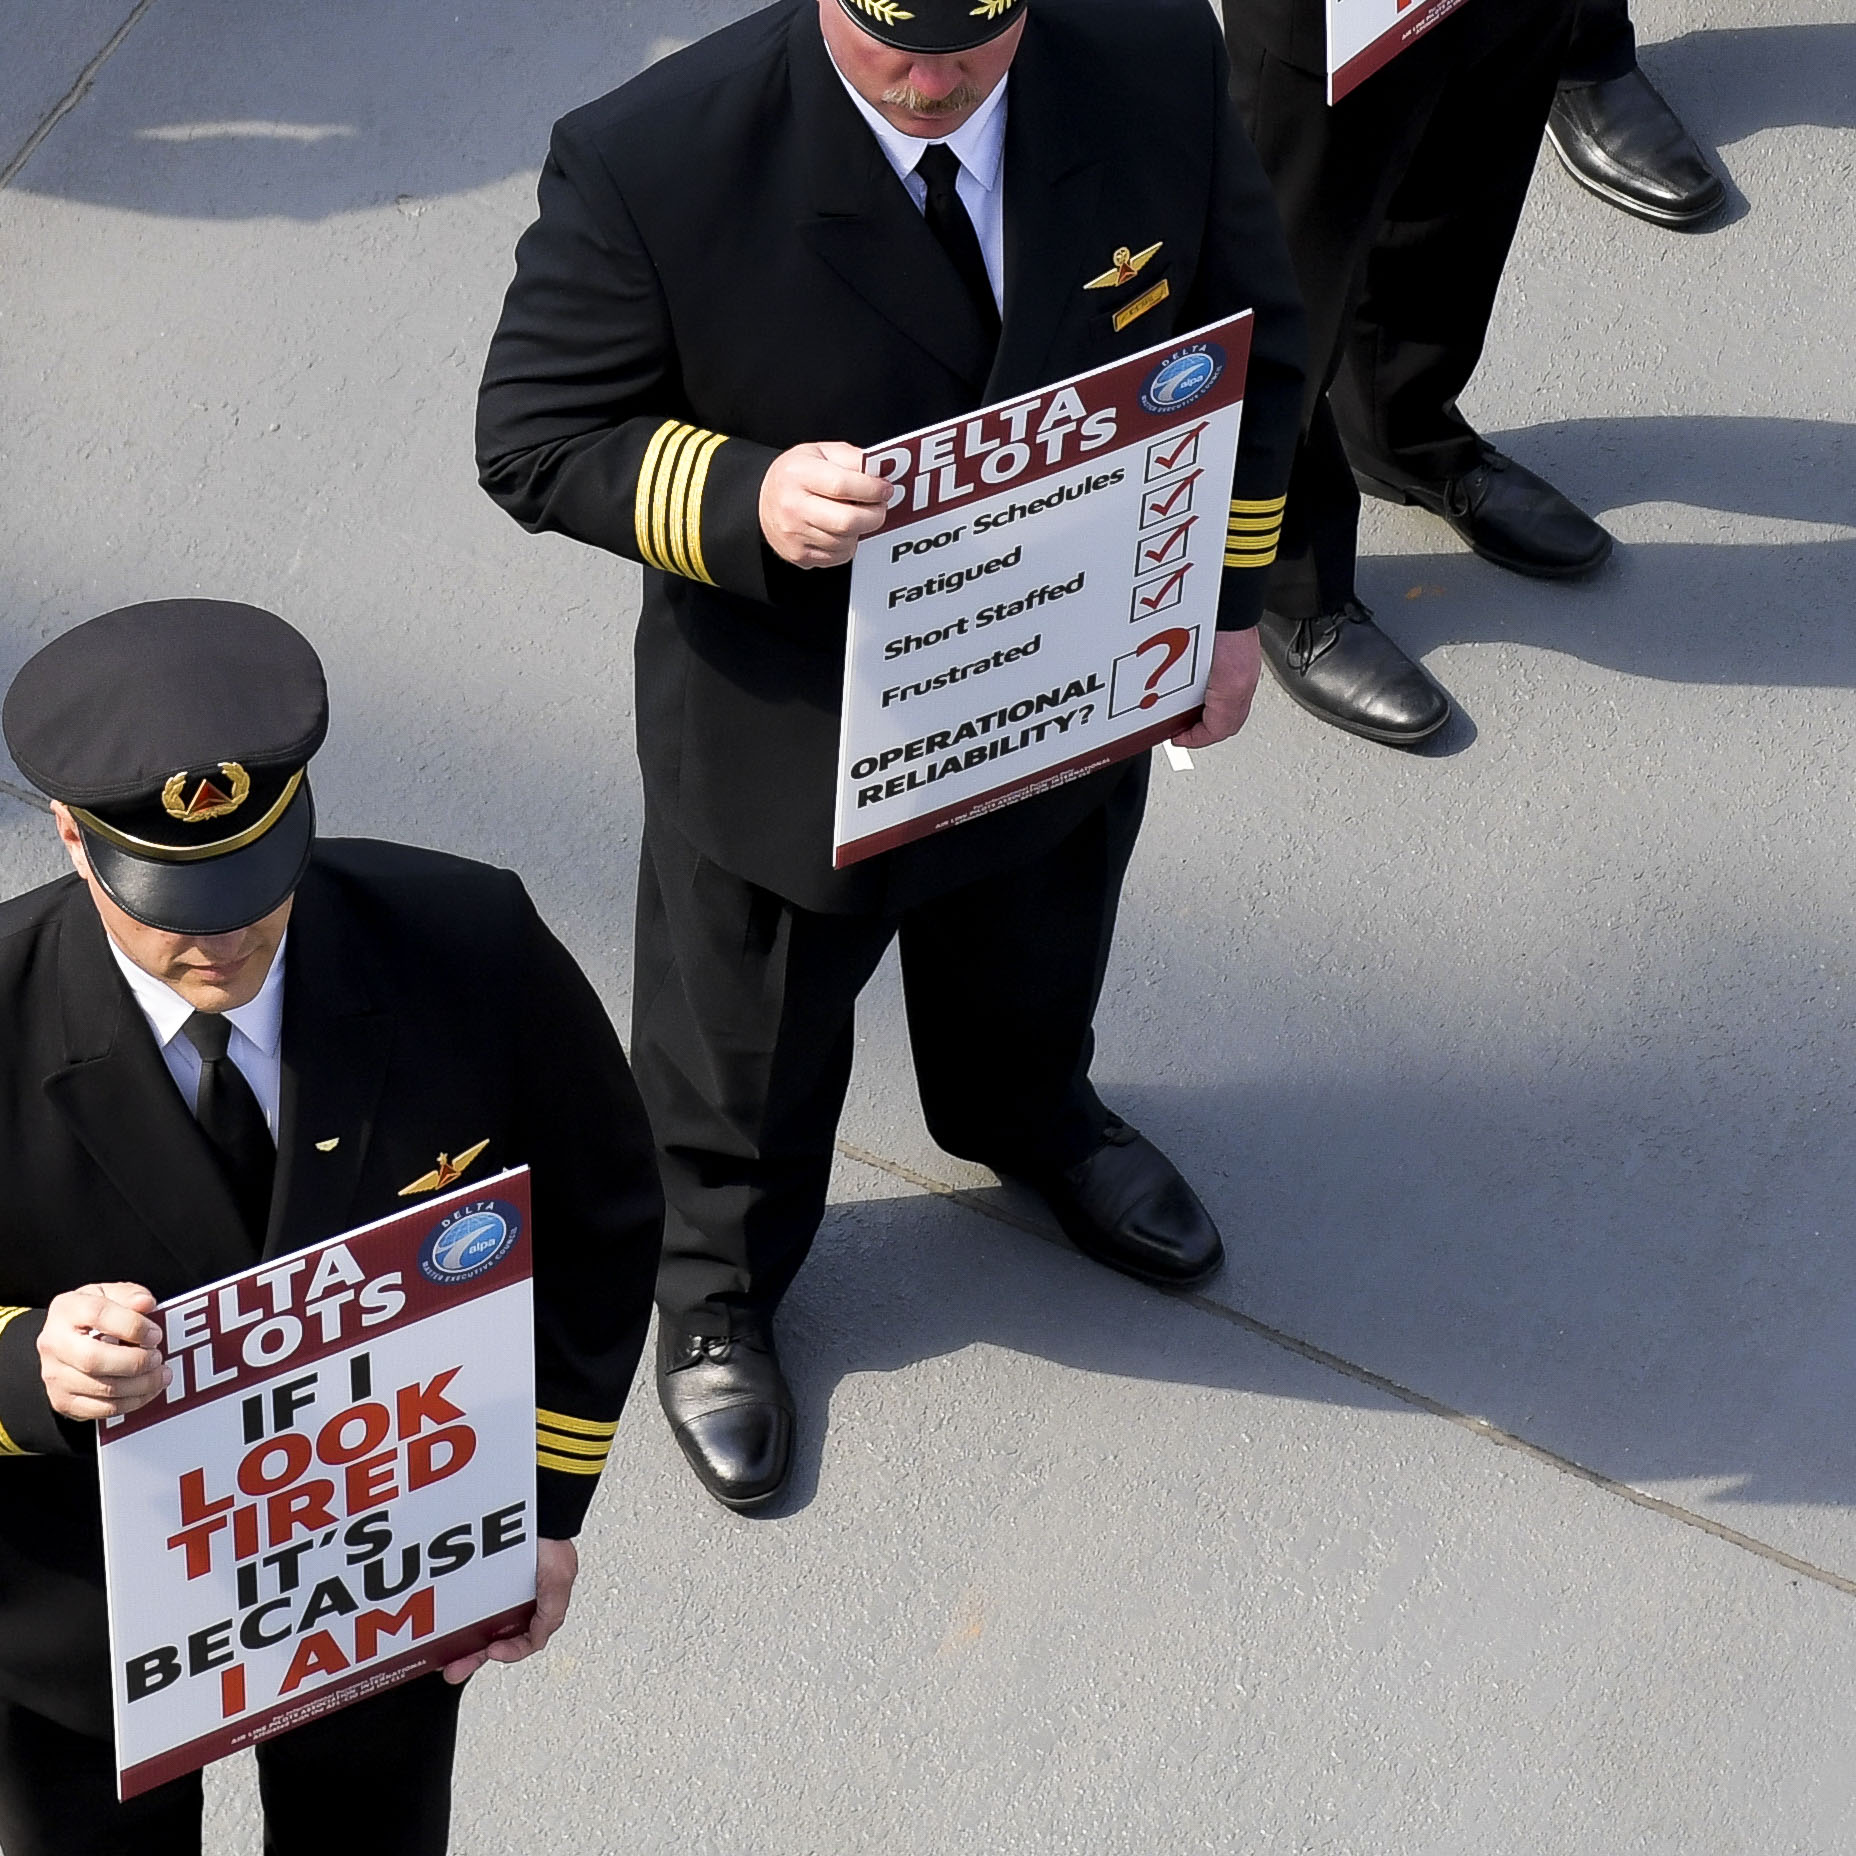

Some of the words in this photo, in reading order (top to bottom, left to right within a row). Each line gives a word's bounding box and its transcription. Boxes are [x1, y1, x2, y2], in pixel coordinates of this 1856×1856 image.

[1161, 344, 1207, 367] DELTA
[865, 387, 1087, 486] DELTA
[890, 525, 967, 563] Poor
[972, 467, 1125, 536] Schedules
[884, 617, 970, 661] Short
[975, 571, 1086, 629] Staffed
[887, 545, 1023, 609] Fatigued
[881, 633, 1042, 708] Frustrated
[850, 671, 1106, 781] OPERATIONAL
[857, 703, 1095, 809] RELIABILITY?
[441, 1201, 495, 1227] DELTA
[468, 1238, 496, 1255] alpa
[165, 1243, 365, 1354] ELTA
[445, 1261, 494, 1282] EXECUTIVE
[106, 1271, 406, 1429] ILOTS
[242, 1372, 319, 1446] IF
[350, 1351, 373, 1404] I
[178, 1364, 467, 1528] LOOK
[166, 1423, 477, 1581] TIRED
[124, 1500, 528, 1704] BECAUSE
[236, 1508, 394, 1611] IT'S
[220, 1662, 246, 1720] I
[276, 1584, 436, 1696] AM
